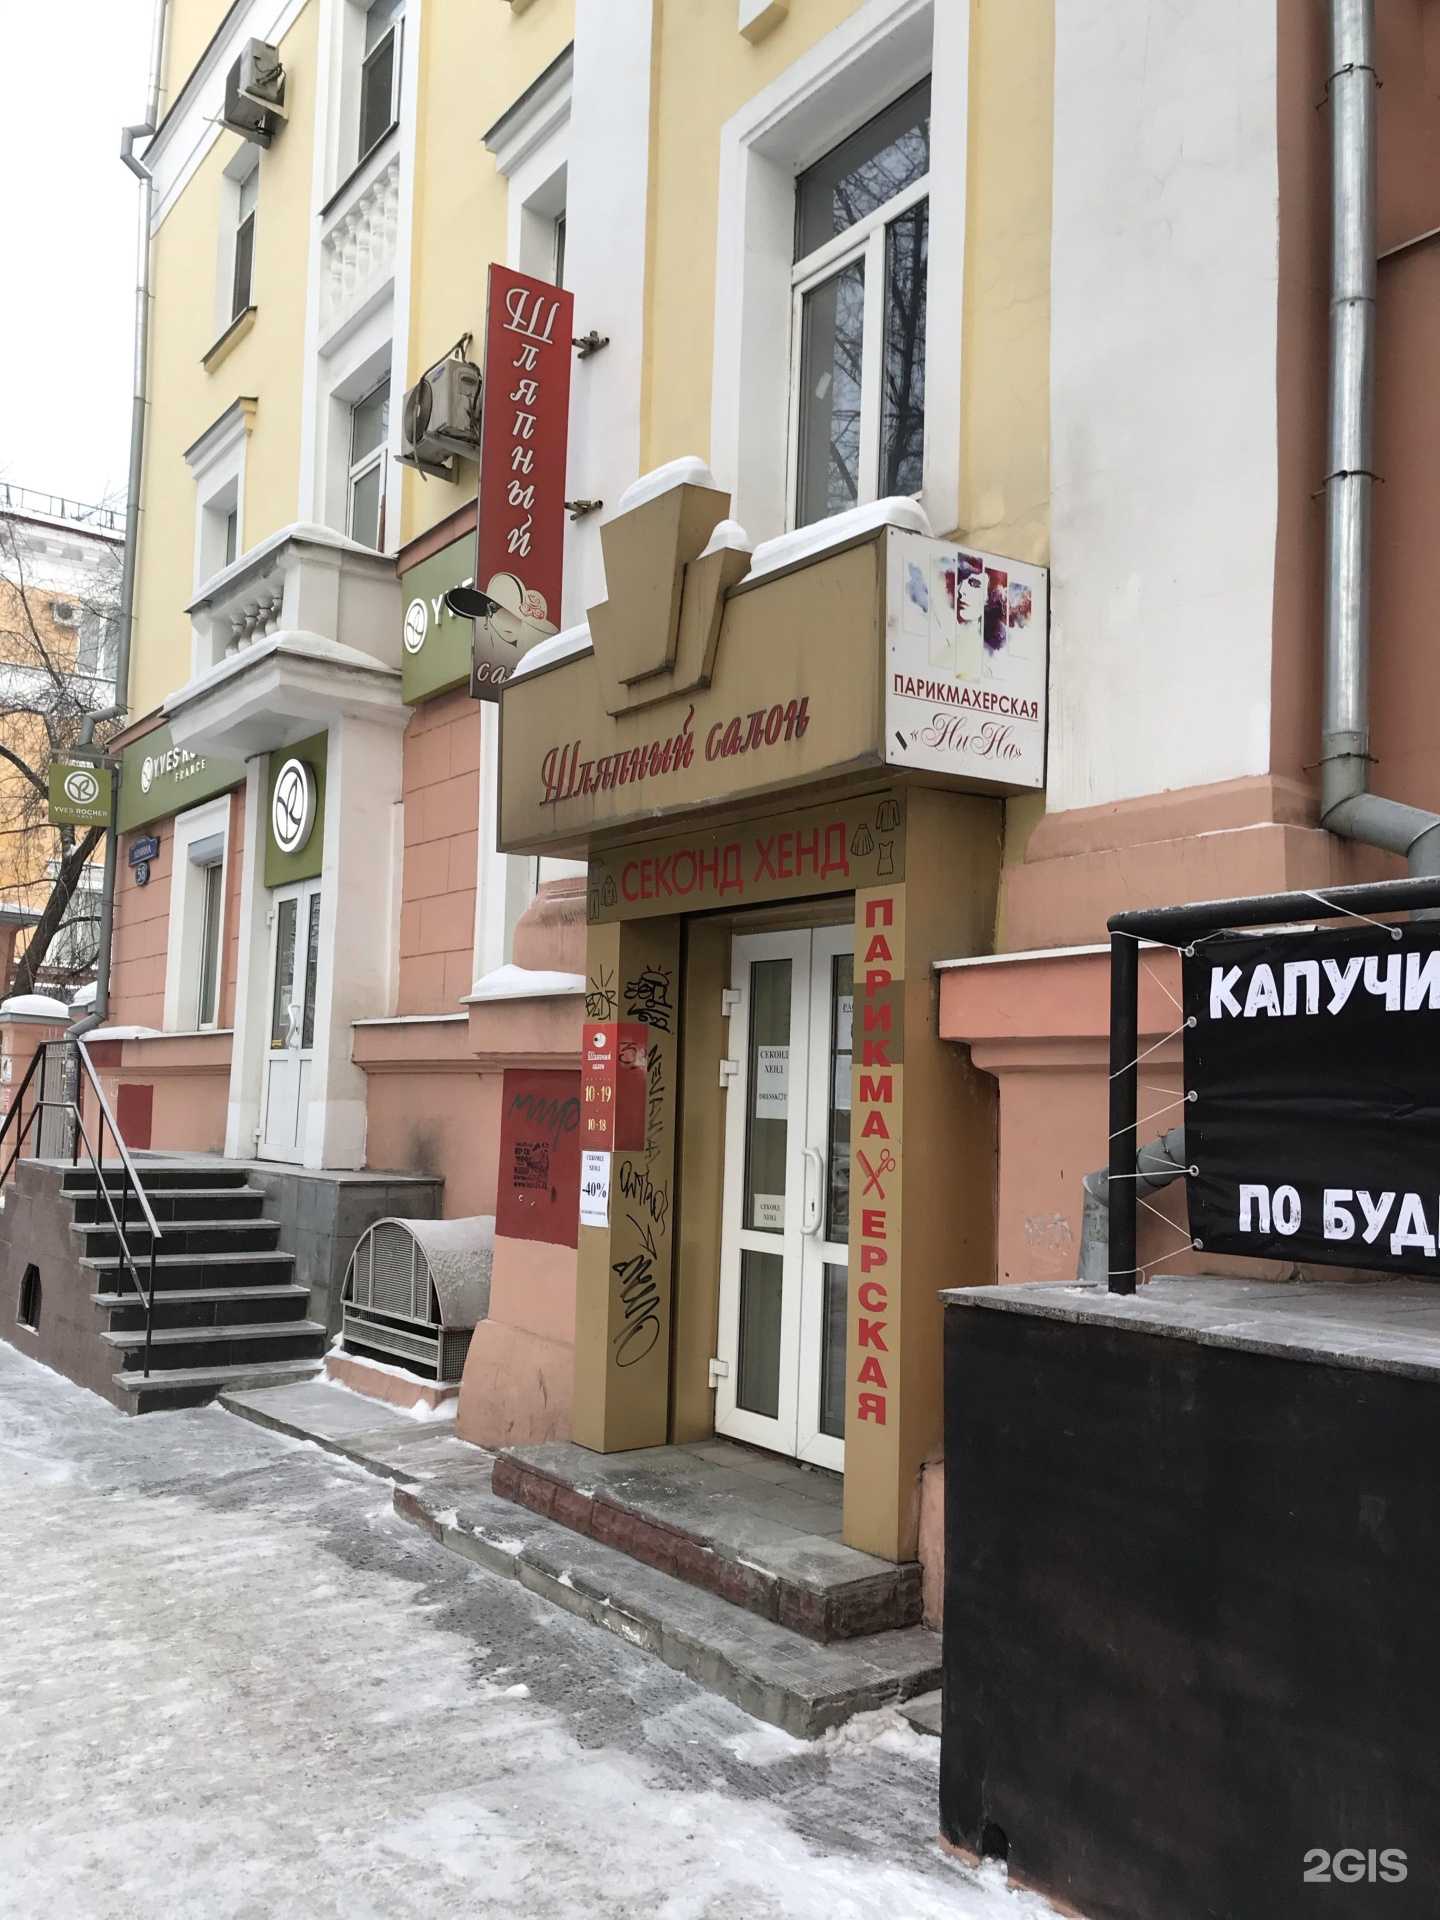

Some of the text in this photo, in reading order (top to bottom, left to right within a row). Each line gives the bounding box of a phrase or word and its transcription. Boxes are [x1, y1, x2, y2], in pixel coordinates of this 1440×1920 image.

[503, 287, 560, 558] Шляпный
[894, 673, 1038, 719] ПАРИКМАХЕРСКАЯ
[153, 747, 180, 777] YVES
[540, 696, 810, 806] Шляпный салон
[76, 808, 108, 817] ROCHER
[621, 822, 850, 903] СЕКОНД ХЕНД
[582, 1181, 607, 1198] -40%
[1238, 1184, 1440, 1258] ПО БУД
